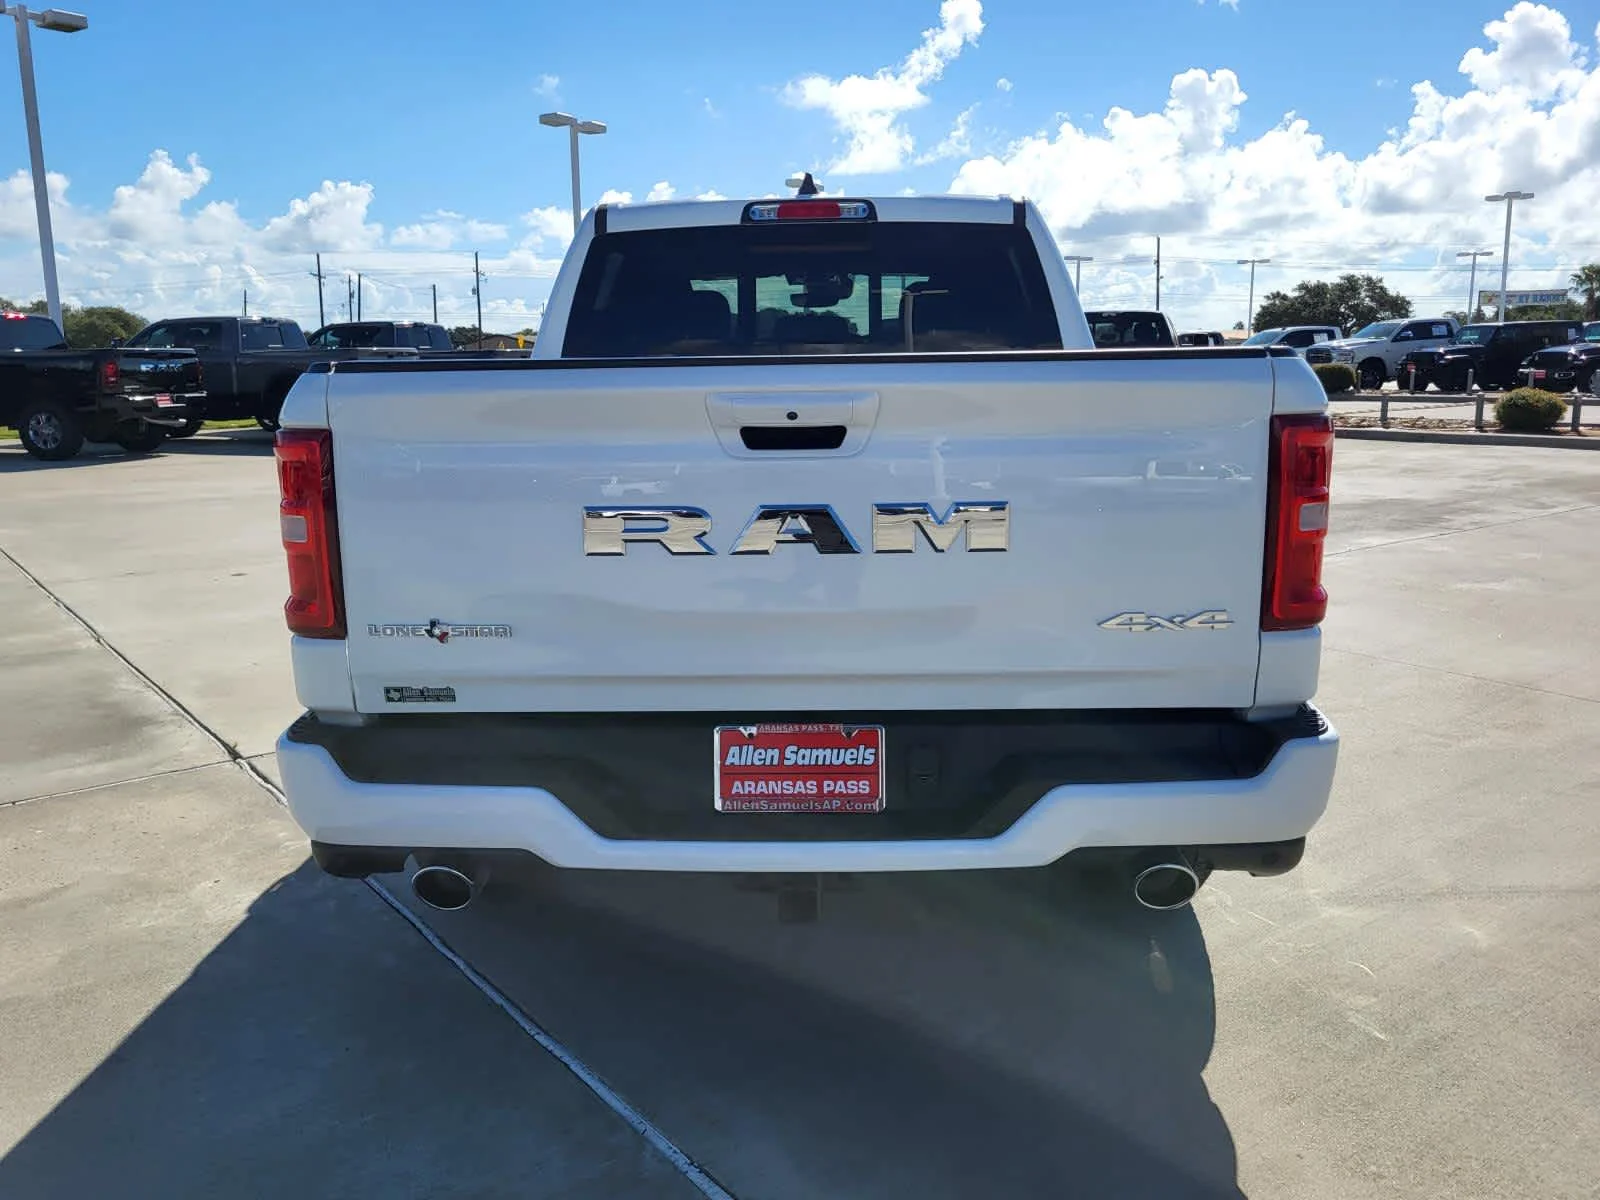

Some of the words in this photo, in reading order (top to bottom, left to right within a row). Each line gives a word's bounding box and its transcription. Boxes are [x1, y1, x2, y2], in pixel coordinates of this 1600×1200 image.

[583, 502, 1010, 556] RAM
[367, 624, 425, 637] LONE
[450, 624, 513, 637] STAR
[758, 724, 800, 732] ARANSAS
[725, 744, 780, 766] Allen
[783, 744, 876, 766] Samuels
[731, 780, 818, 794] ARANSAS
[823, 780, 870, 794] PASS
[723, 799, 876, 811] AllenSamuelsAP.com
